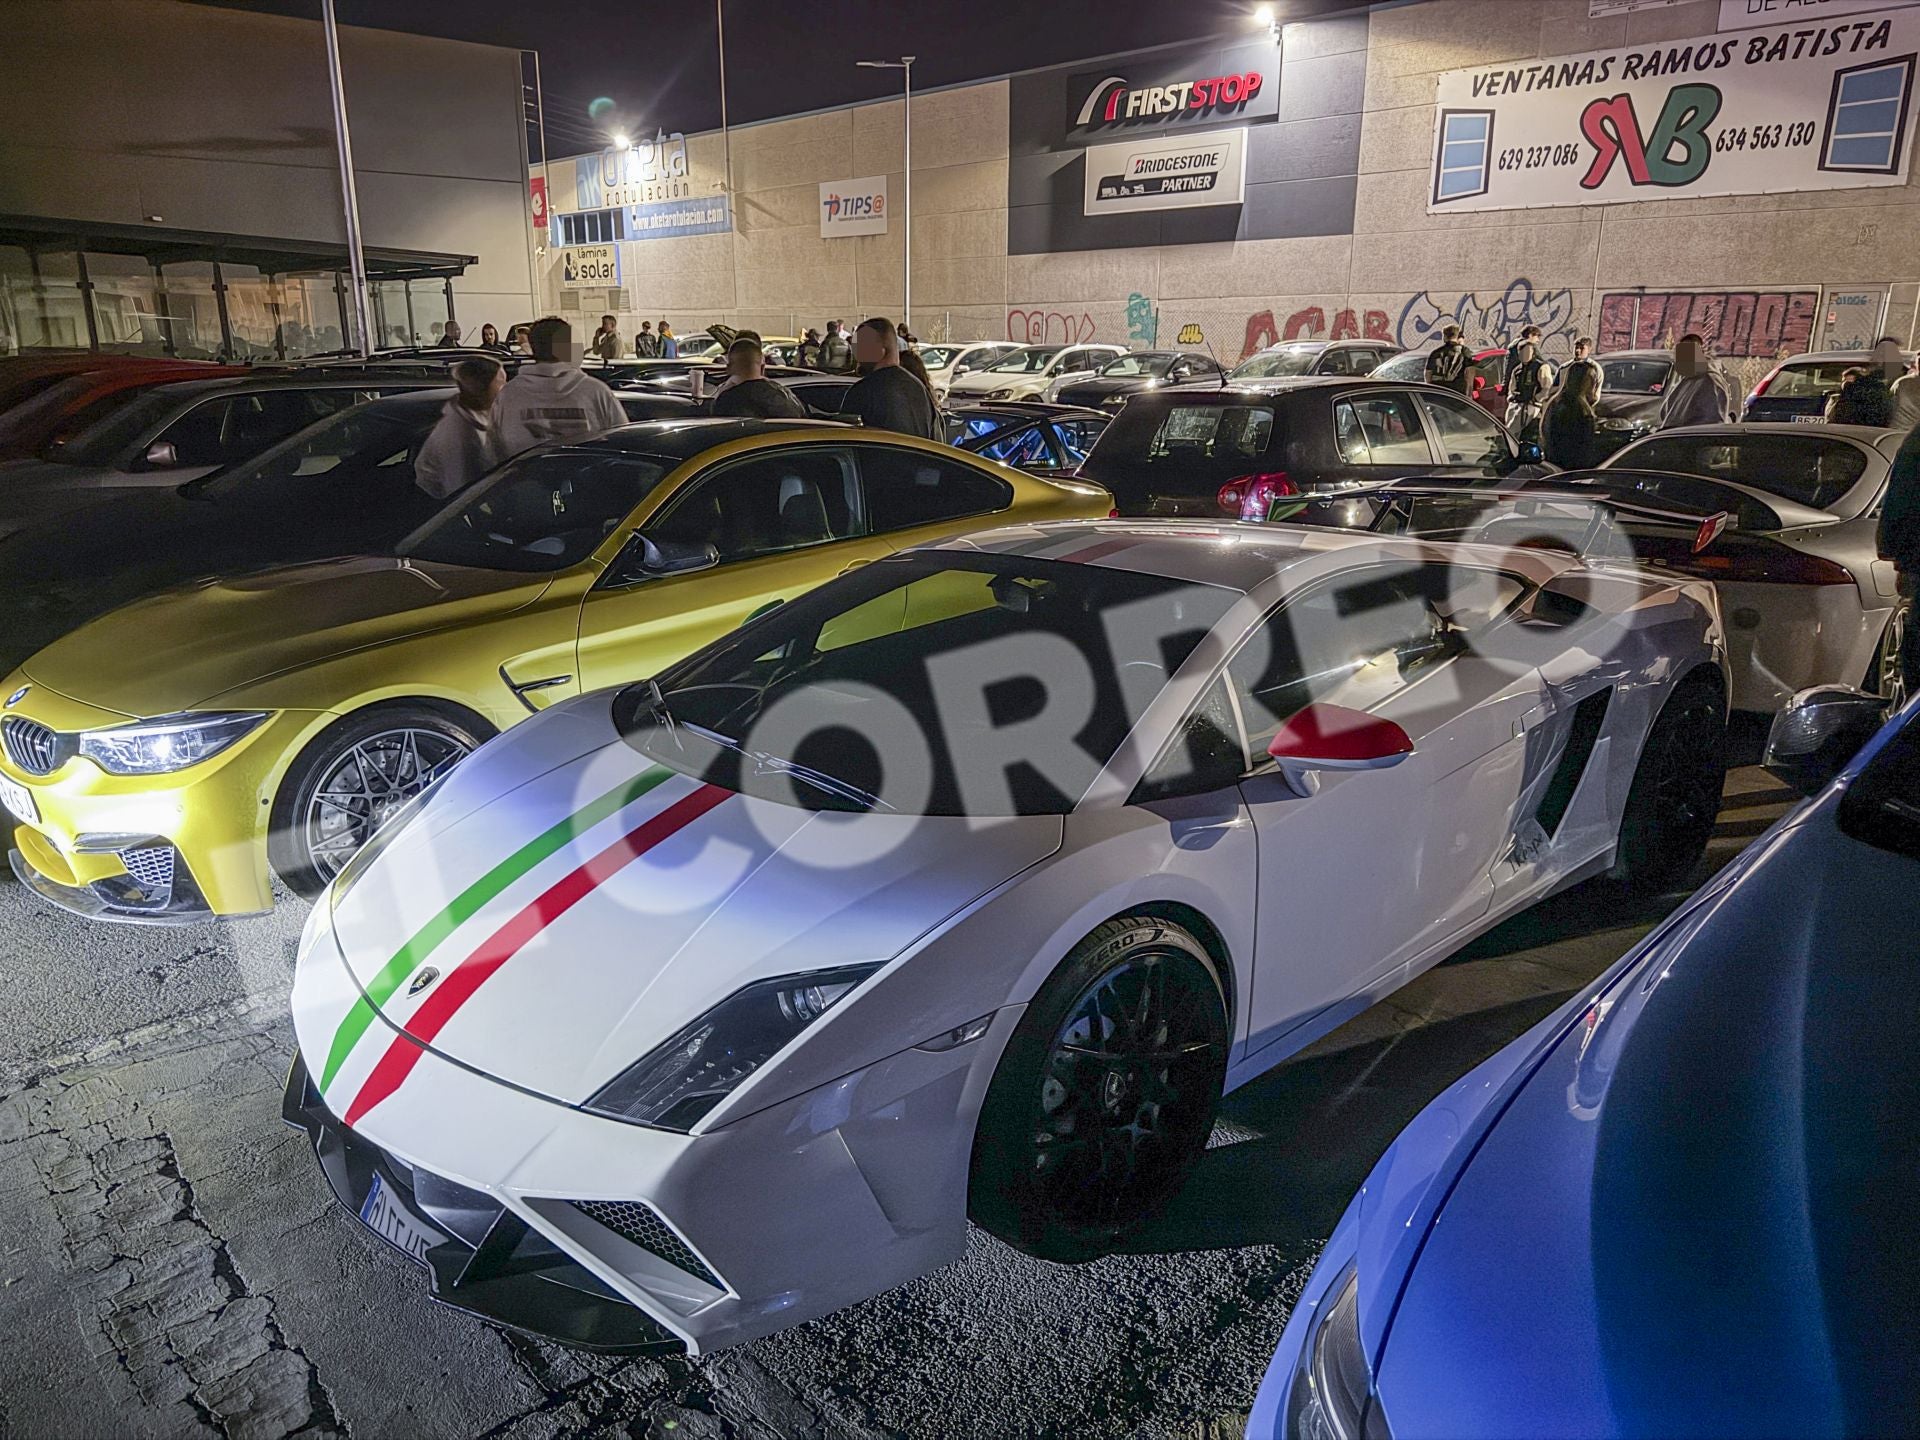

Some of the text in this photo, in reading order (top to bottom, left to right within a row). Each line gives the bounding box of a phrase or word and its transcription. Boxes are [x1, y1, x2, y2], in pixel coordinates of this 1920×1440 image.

[1472, 19, 1892, 99] VENTANAS RAMOS BATISTA
[1715, 120, 1816, 153] 634 563 130
[1134, 152, 1219, 174] BRIDGESTONE
[1499, 142, 1579, 171] 629 237 086
[605, 179, 689, 206] rotulación
[1161, 175, 1211, 192] PARTNER
[577, 247, 607, 259] lámina
[581, 259, 614, 279] solar
